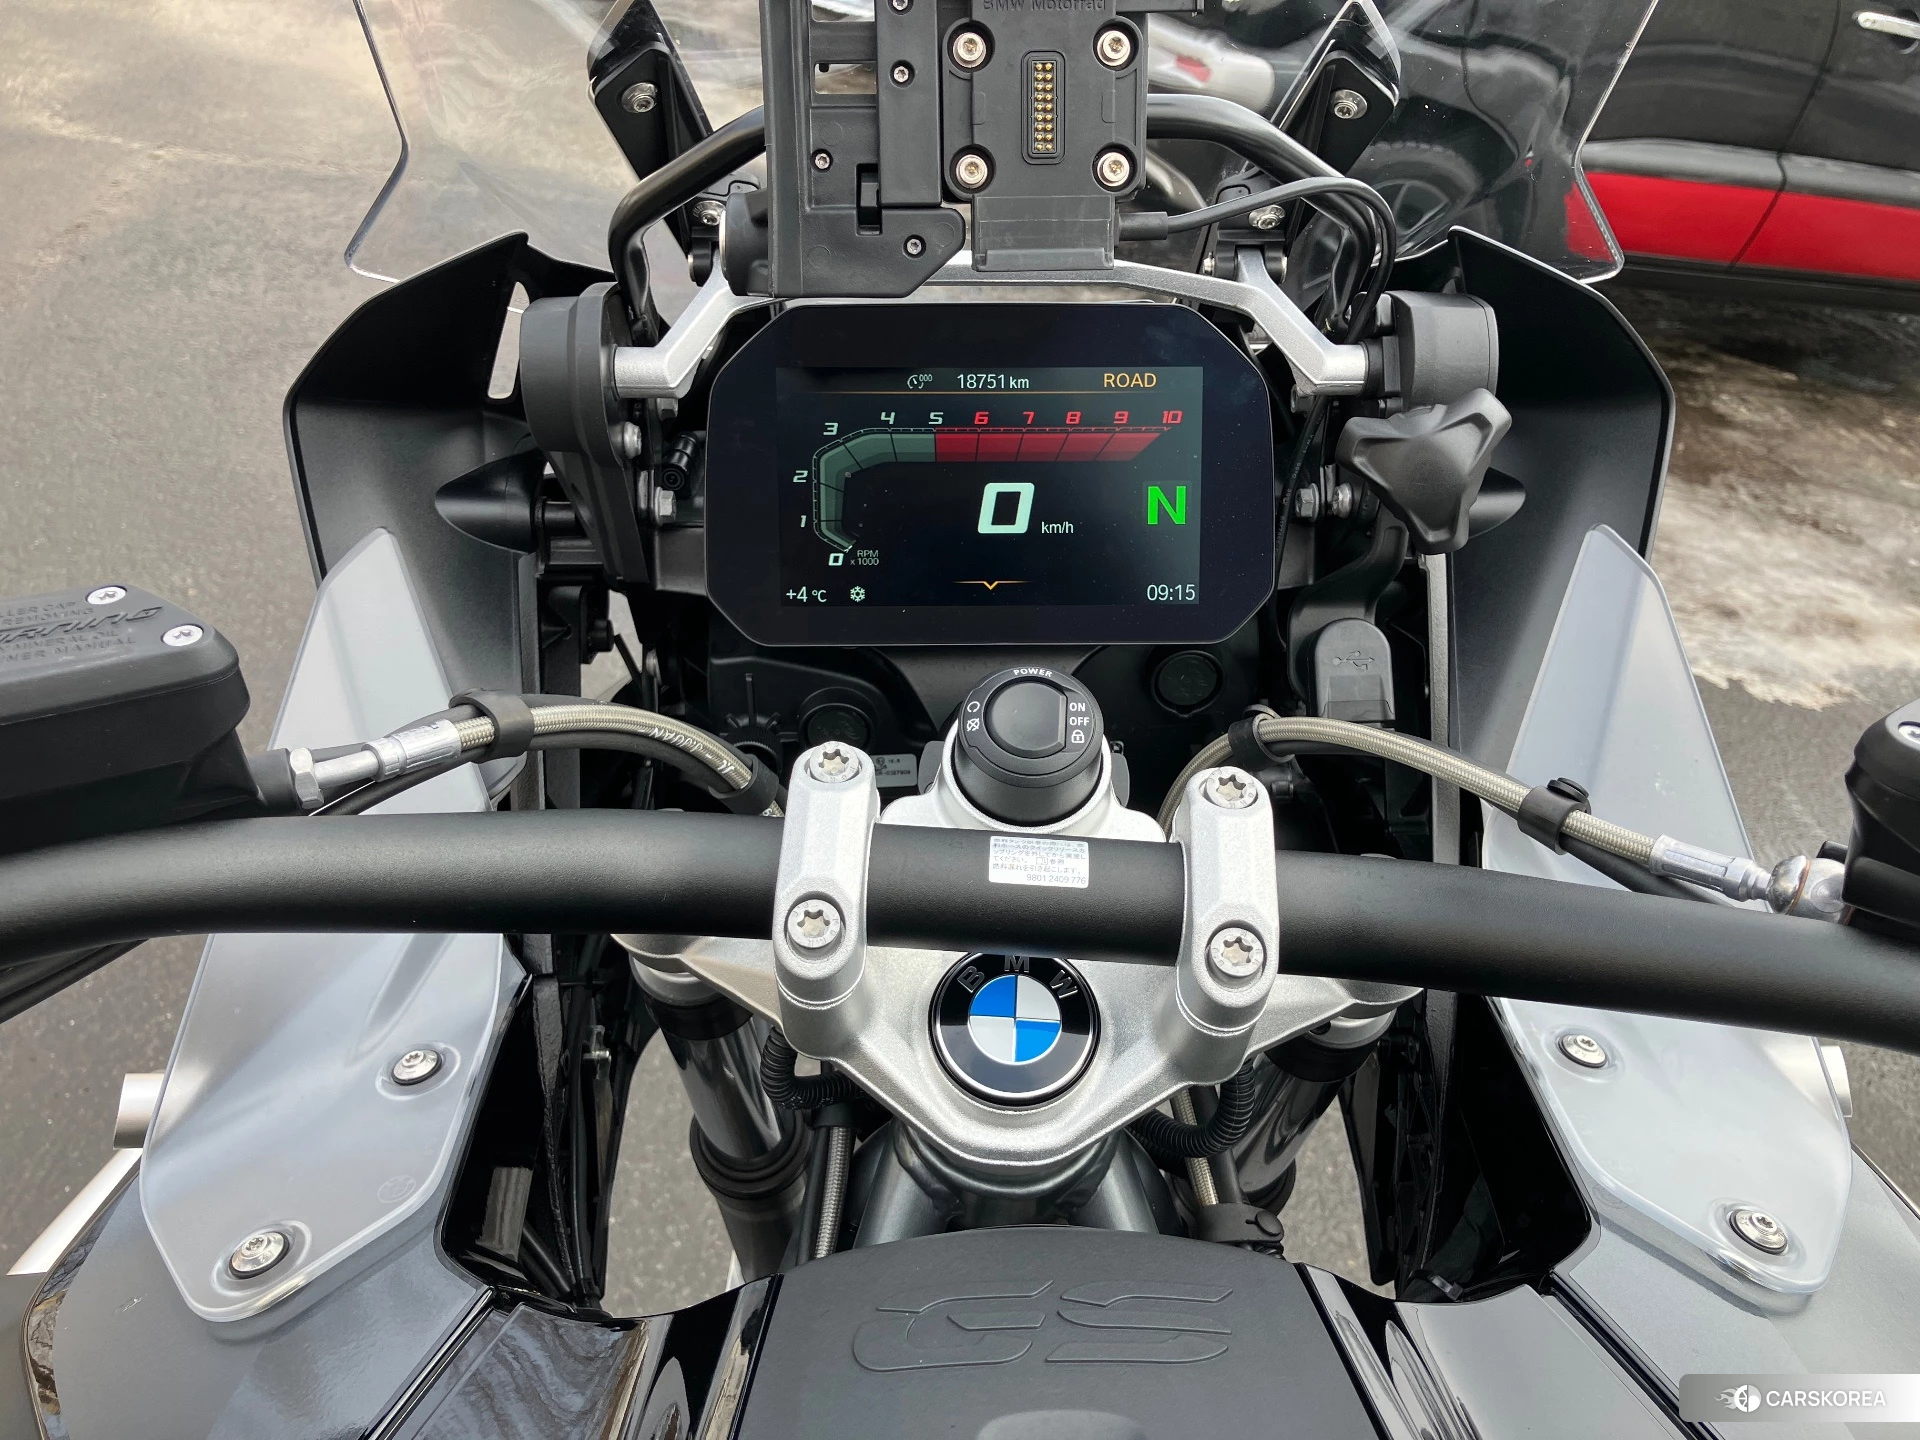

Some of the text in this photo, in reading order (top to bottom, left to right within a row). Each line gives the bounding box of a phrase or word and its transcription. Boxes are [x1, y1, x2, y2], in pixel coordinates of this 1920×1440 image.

[983, 0, 1106, 10] BMW Motorrad
[957, 374, 1005, 389] 18751
[1009, 375, 1030, 389] km
[1103, 373, 1157, 388] ROAD
[880, 411, 1182, 425] 4 5 6 7 8 9 10
[823, 423, 839, 436] 3
[793, 470, 808, 483] 2
[977, 482, 1074, 534] 0 km/h
[1147, 485, 1187, 525] N
[800, 515, 807, 527] 1
[828, 553, 844, 566] 0
[857, 549, 879, 558] RPM
[785, 587, 808, 602] +4
[1147, 585, 1196, 601] 09:15
[1013, 668, 1053, 678] POWER
[1069, 702, 1086, 712] ON
[1069, 717, 1090, 726] OFF
[1026, 873, 1047, 882] 9801
[957, 955, 1079, 999] BMW
[853, 1280, 1234, 1373] GS
